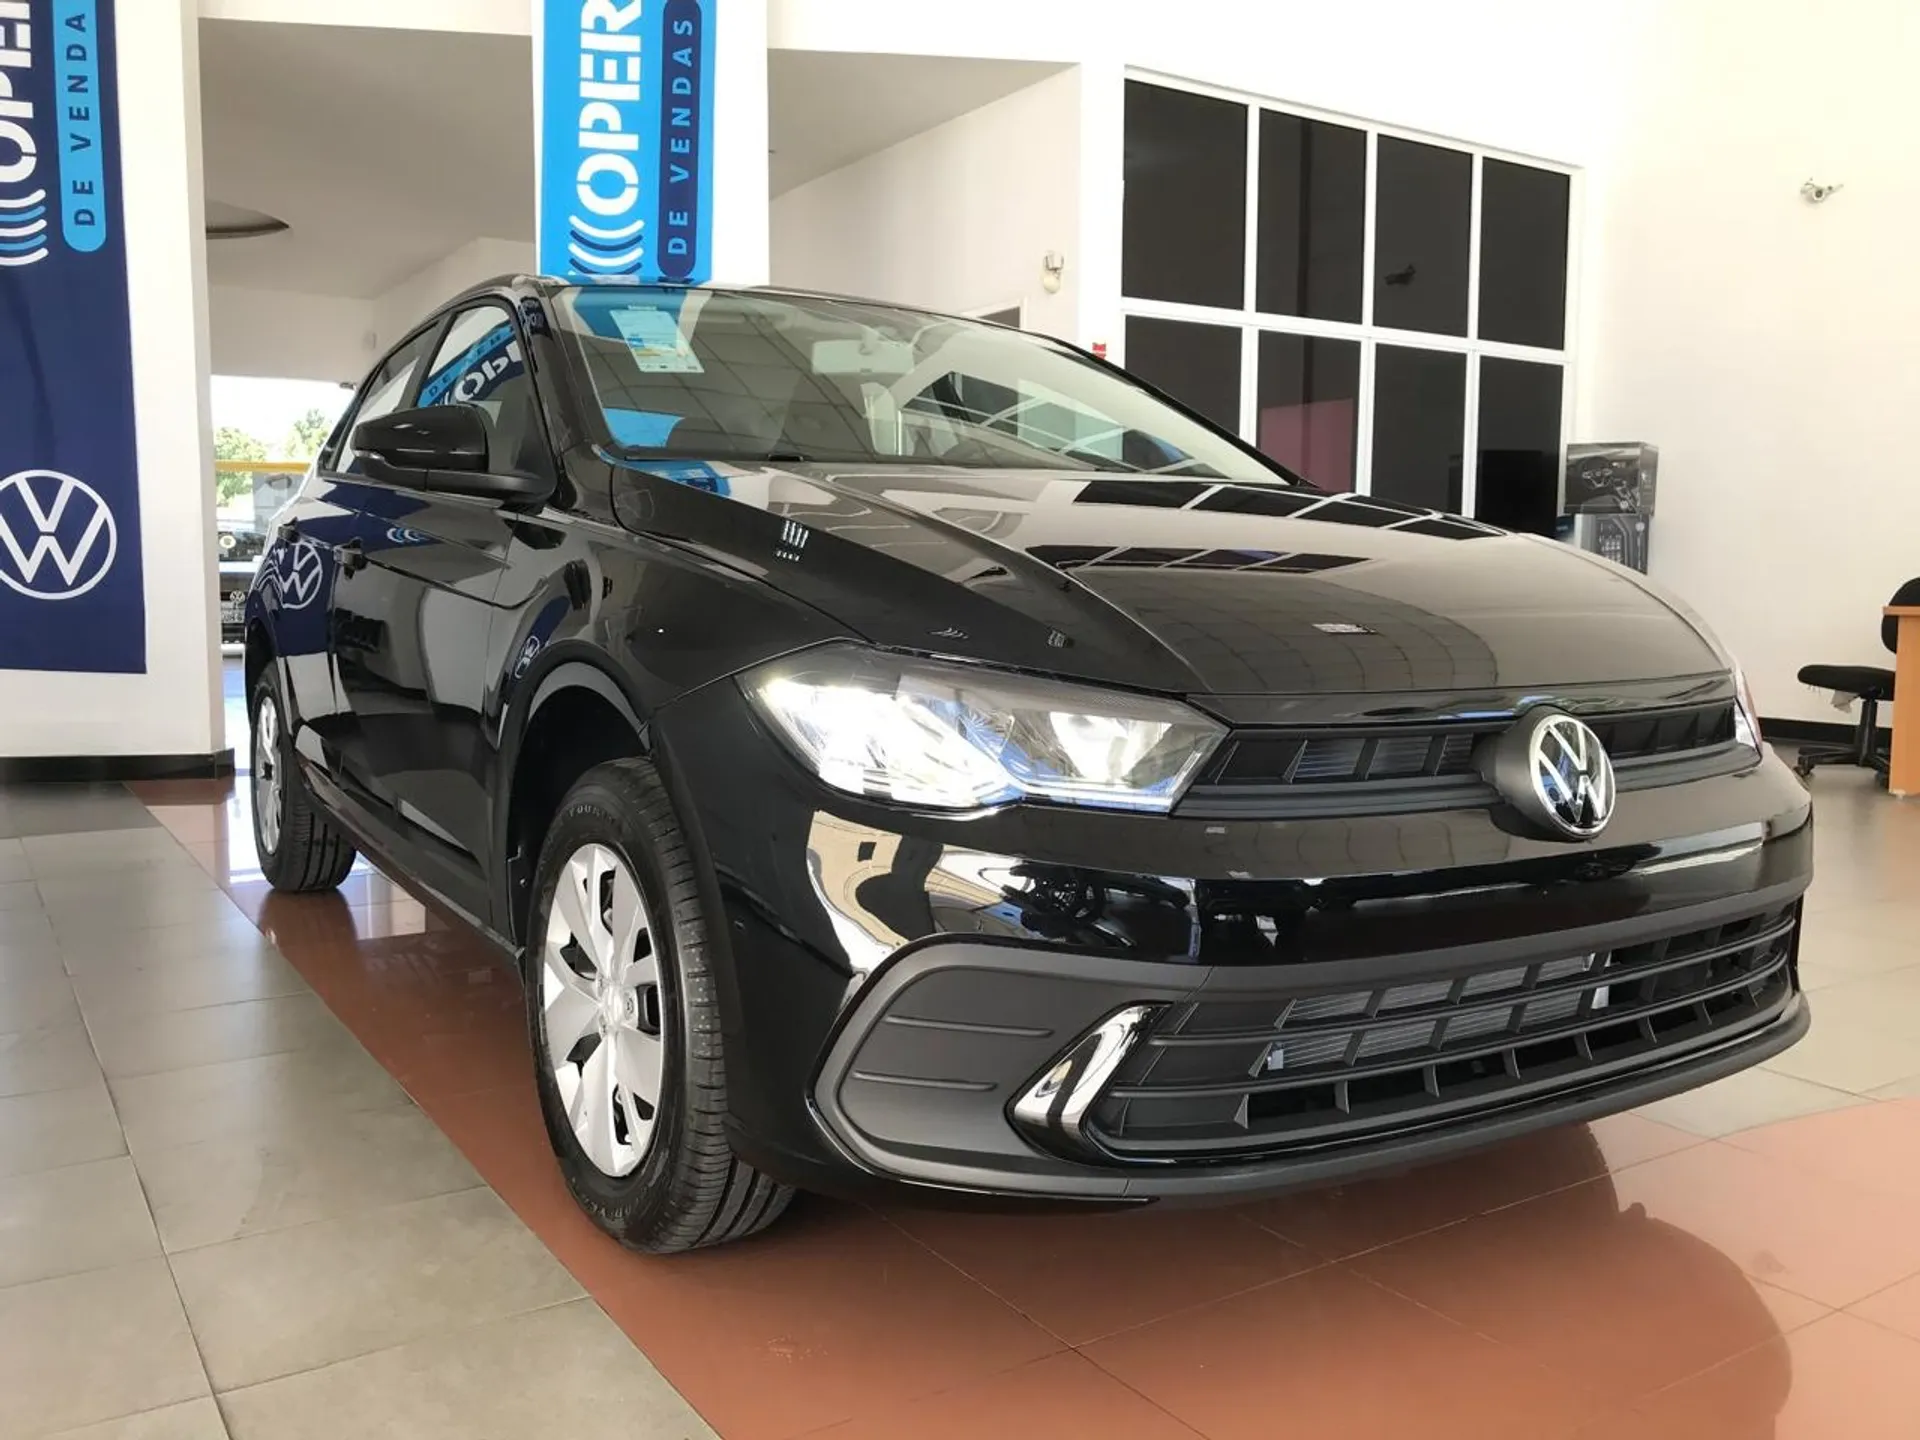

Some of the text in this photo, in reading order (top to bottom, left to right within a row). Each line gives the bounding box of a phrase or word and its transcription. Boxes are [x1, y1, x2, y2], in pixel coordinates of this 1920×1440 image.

[65, 13, 96, 227] DE VENDA
[576, 0, 642, 216] OPER
[667, 19, 693, 255] DE VENDAS
[0, 473, 113, 591] VW
[1533, 719, 1611, 830] VW
